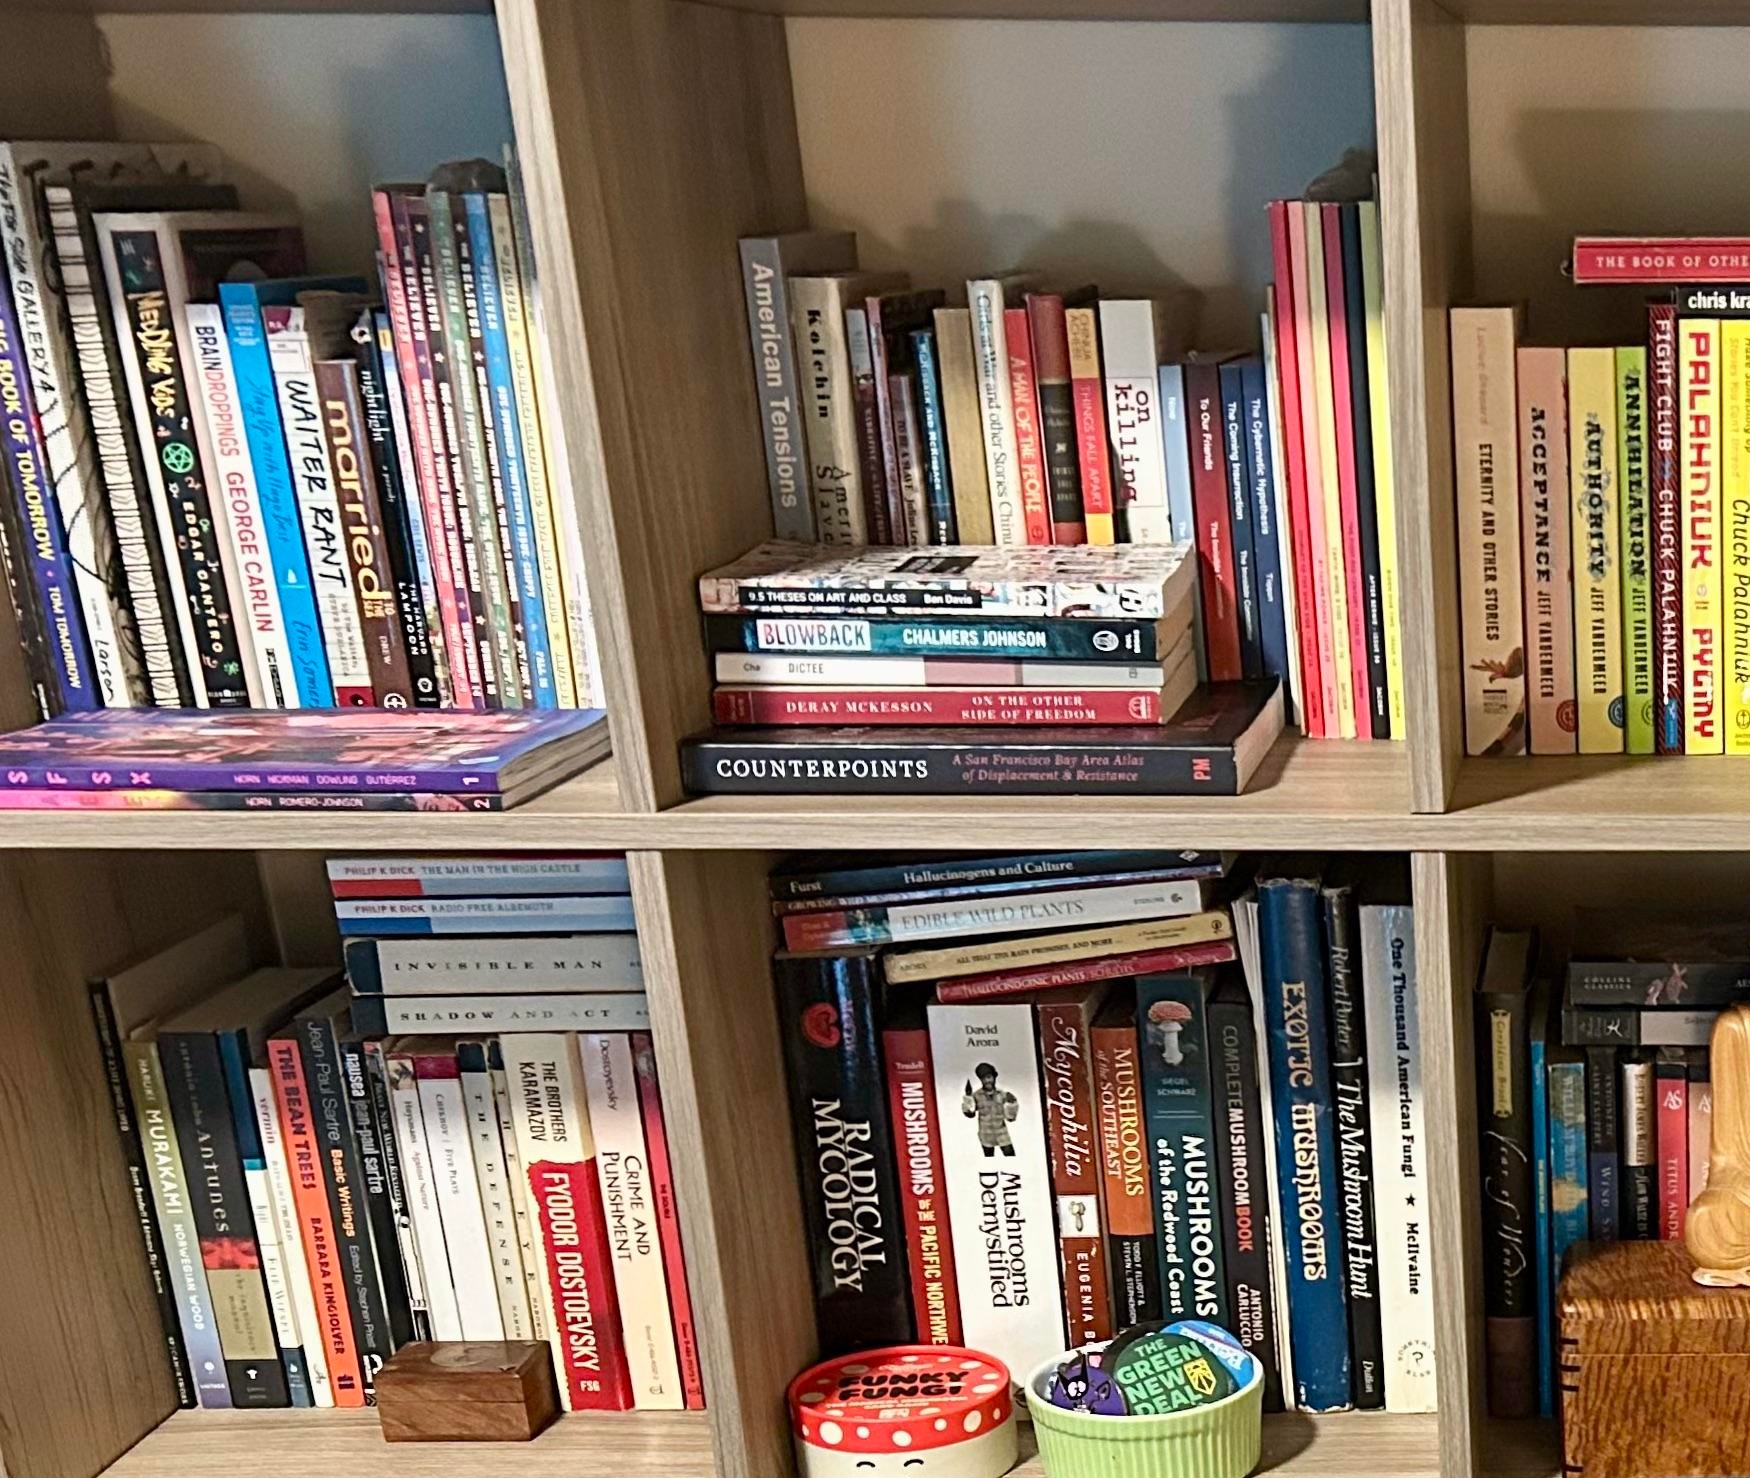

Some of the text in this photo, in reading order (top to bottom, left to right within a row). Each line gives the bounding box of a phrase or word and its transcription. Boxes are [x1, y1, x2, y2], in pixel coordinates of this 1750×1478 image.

[1596, 256, 1625, 269] THE
[1629, 256, 1676, 268] BOOK
[1688, 294, 1726, 309] chris
[750, 262, 798, 508] American Tensions
[194, 326, 276, 633] BRAINDROPPINGS GEORGE CARLIN
[285, 380, 347, 589] WAITER RANT
[1113, 384, 1138, 504] killing
[1688, 332, 1712, 568] PALAHNIUK
[17, 449, 55, 561] TOMORROW
[327, 400, 379, 601] married
[762, 624, 1046, 649] BLOWBACK CHALMERS JOHNSON
[1731, 498, 1750, 683] Chuck Palahniuk
[786, 701, 934, 713] DERAY MCKESSON
[961, 709, 994, 721] SIDE
[1025, 709, 1096, 721] FREEDOM
[971, 695, 1083, 706] ON THE OTHER
[716, 758, 928, 780] COUNTERPOINTS
[964, 1025, 998, 1036] David
[967, 1037, 999, 1048] Arora
[276, 1046, 317, 1190] THE BEAN TREES
[519, 1061, 545, 1141] KARAMAZOV
[542, 1061, 567, 1143] THE BROTHERS
[902, 1081, 935, 1196] MUSHROOMS
[147, 1108, 183, 1215] MURAKAMI
[602, 1150, 633, 1263] PUNISHMENT
[813, 1099, 862, 1293] MYCOLOGY
[841, 1121, 885, 1264] RADICAL
[542, 1172, 600, 1372] FYODOR DOSTOEVSKY
[631, 1221, 650, 1256] AND
[978, 1170, 1008, 1309] Demystified
[1000, 1170, 1029, 1307] Mushrooms
[1182, 1136, 1218, 1317] MUSHROOMS
[838, 1371, 970, 1388] FUNKY
[1116, 1342, 1203, 1384] GREEN
[1124, 1366, 1186, 1404] NEW
[1134, 1339, 1165, 1359] THE
